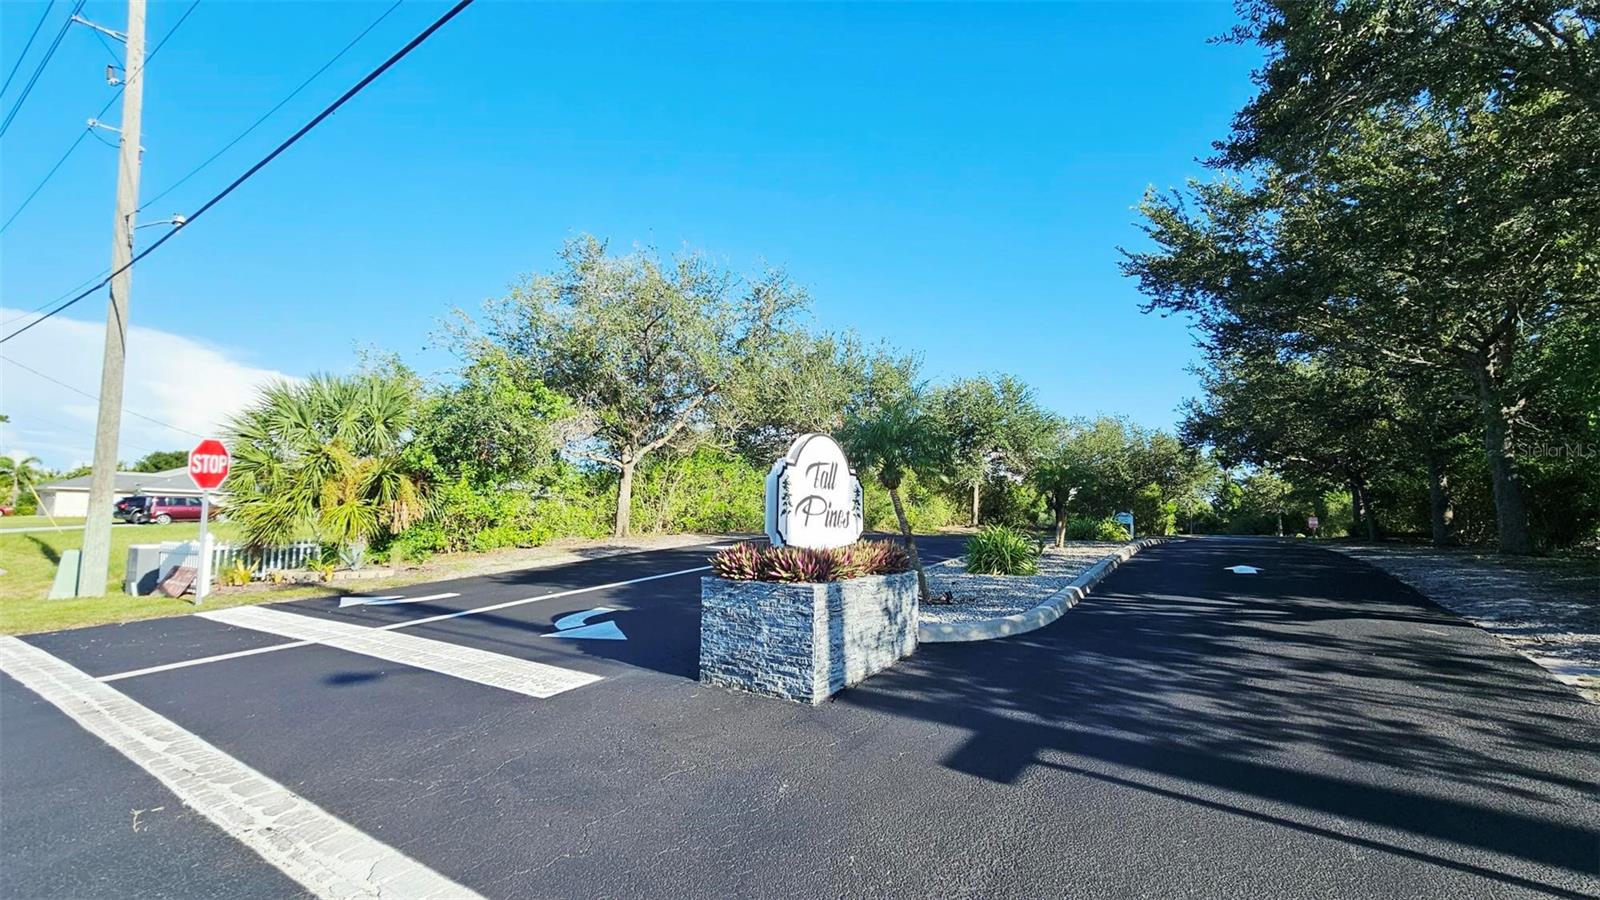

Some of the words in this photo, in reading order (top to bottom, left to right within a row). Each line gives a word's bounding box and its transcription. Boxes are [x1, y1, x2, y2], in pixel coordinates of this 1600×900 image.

[192, 454, 227, 474] STOP
[805, 461, 838, 490] Tall
[795, 495, 850, 529] Pines
